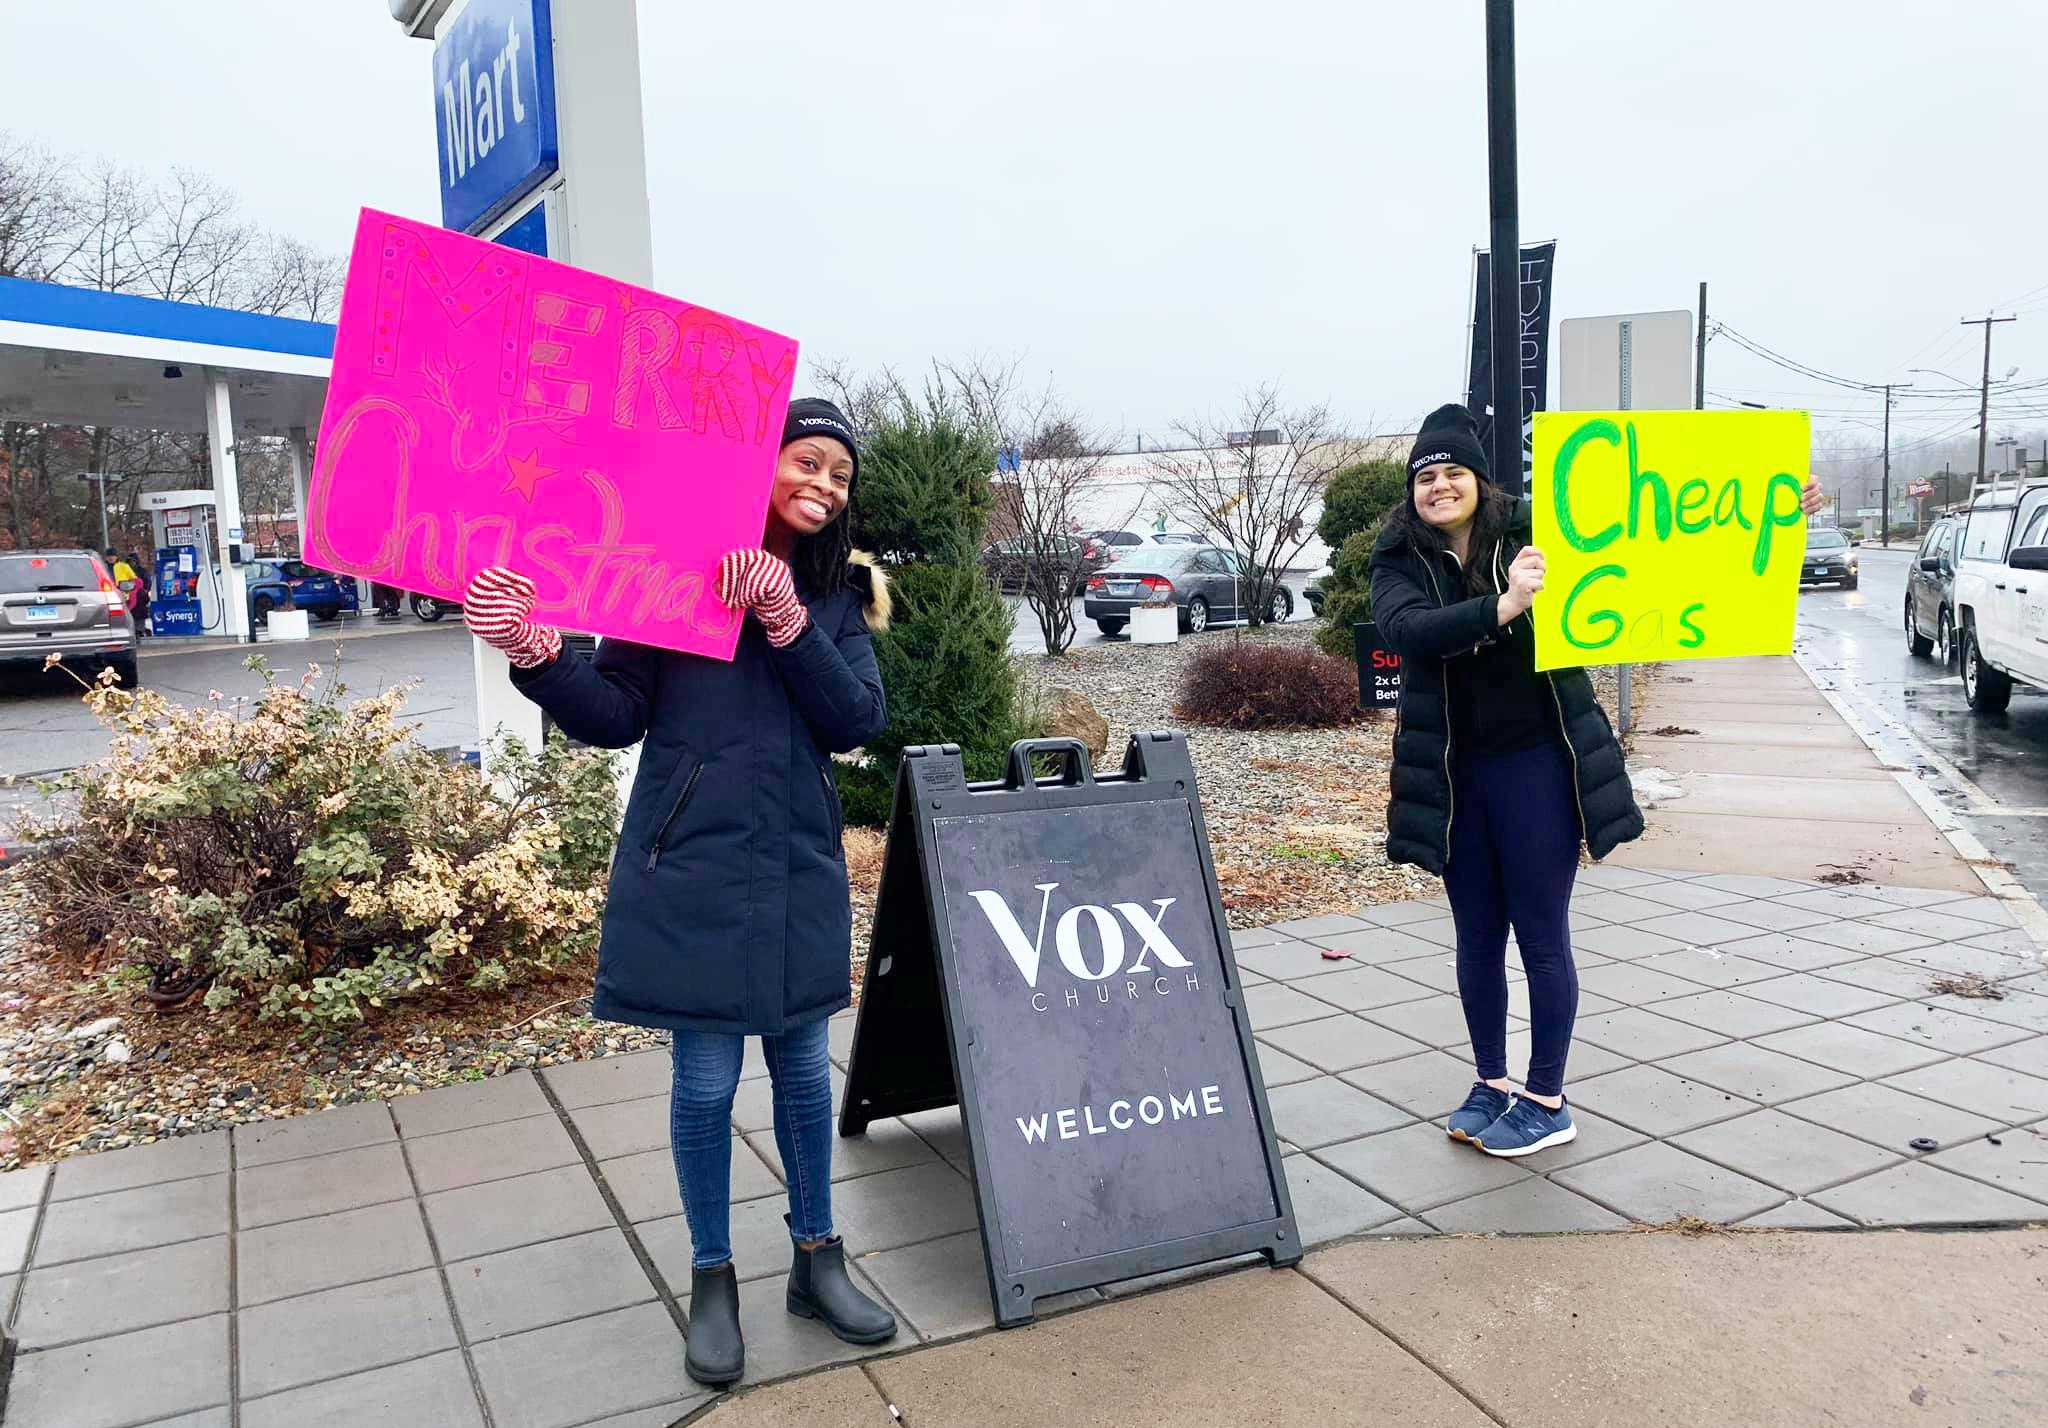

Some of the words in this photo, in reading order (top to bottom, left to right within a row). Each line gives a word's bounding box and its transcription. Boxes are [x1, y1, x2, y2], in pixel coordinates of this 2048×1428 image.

[443, 15, 525, 188] Mart
[370, 222, 797, 448] MERRY
[1552, 418, 1803, 577] Cheap
[1561, 564, 1706, 650] Gas
[1371, 650, 1402, 668] Su
[1374, 675, 1390, 686] 2x
[1030, 973, 1201, 1012] CHURCH
[1015, 1085, 1224, 1145] WELCOME
